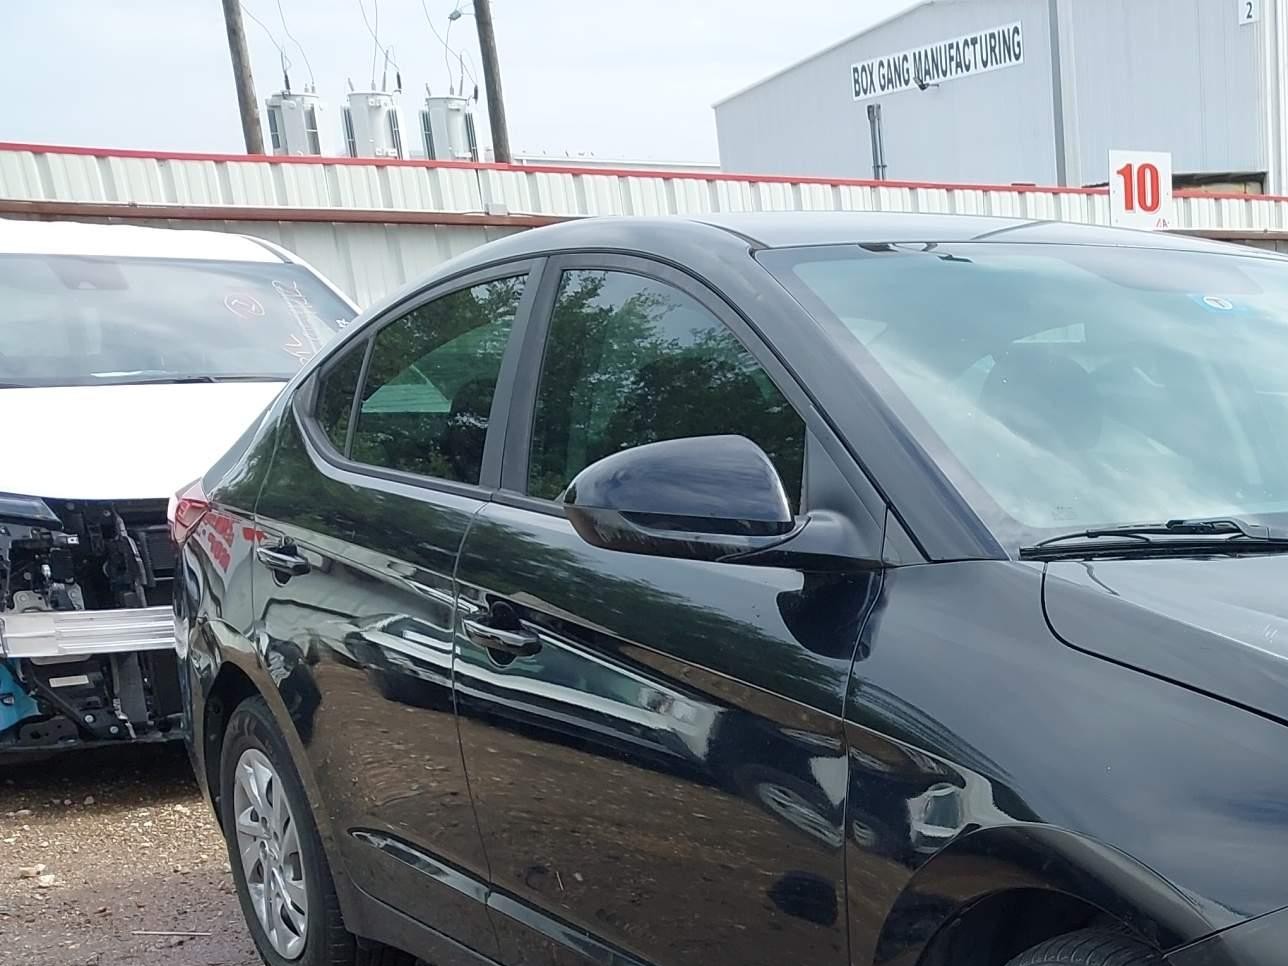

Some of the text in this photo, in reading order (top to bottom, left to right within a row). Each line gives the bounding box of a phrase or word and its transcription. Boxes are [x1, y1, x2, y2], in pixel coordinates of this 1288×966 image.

[1246, 2, 1253, 19] 2
[852, 25, 1022, 97] BOX GANG MANUFACTURING
[1117, 163, 1160, 212] 10
